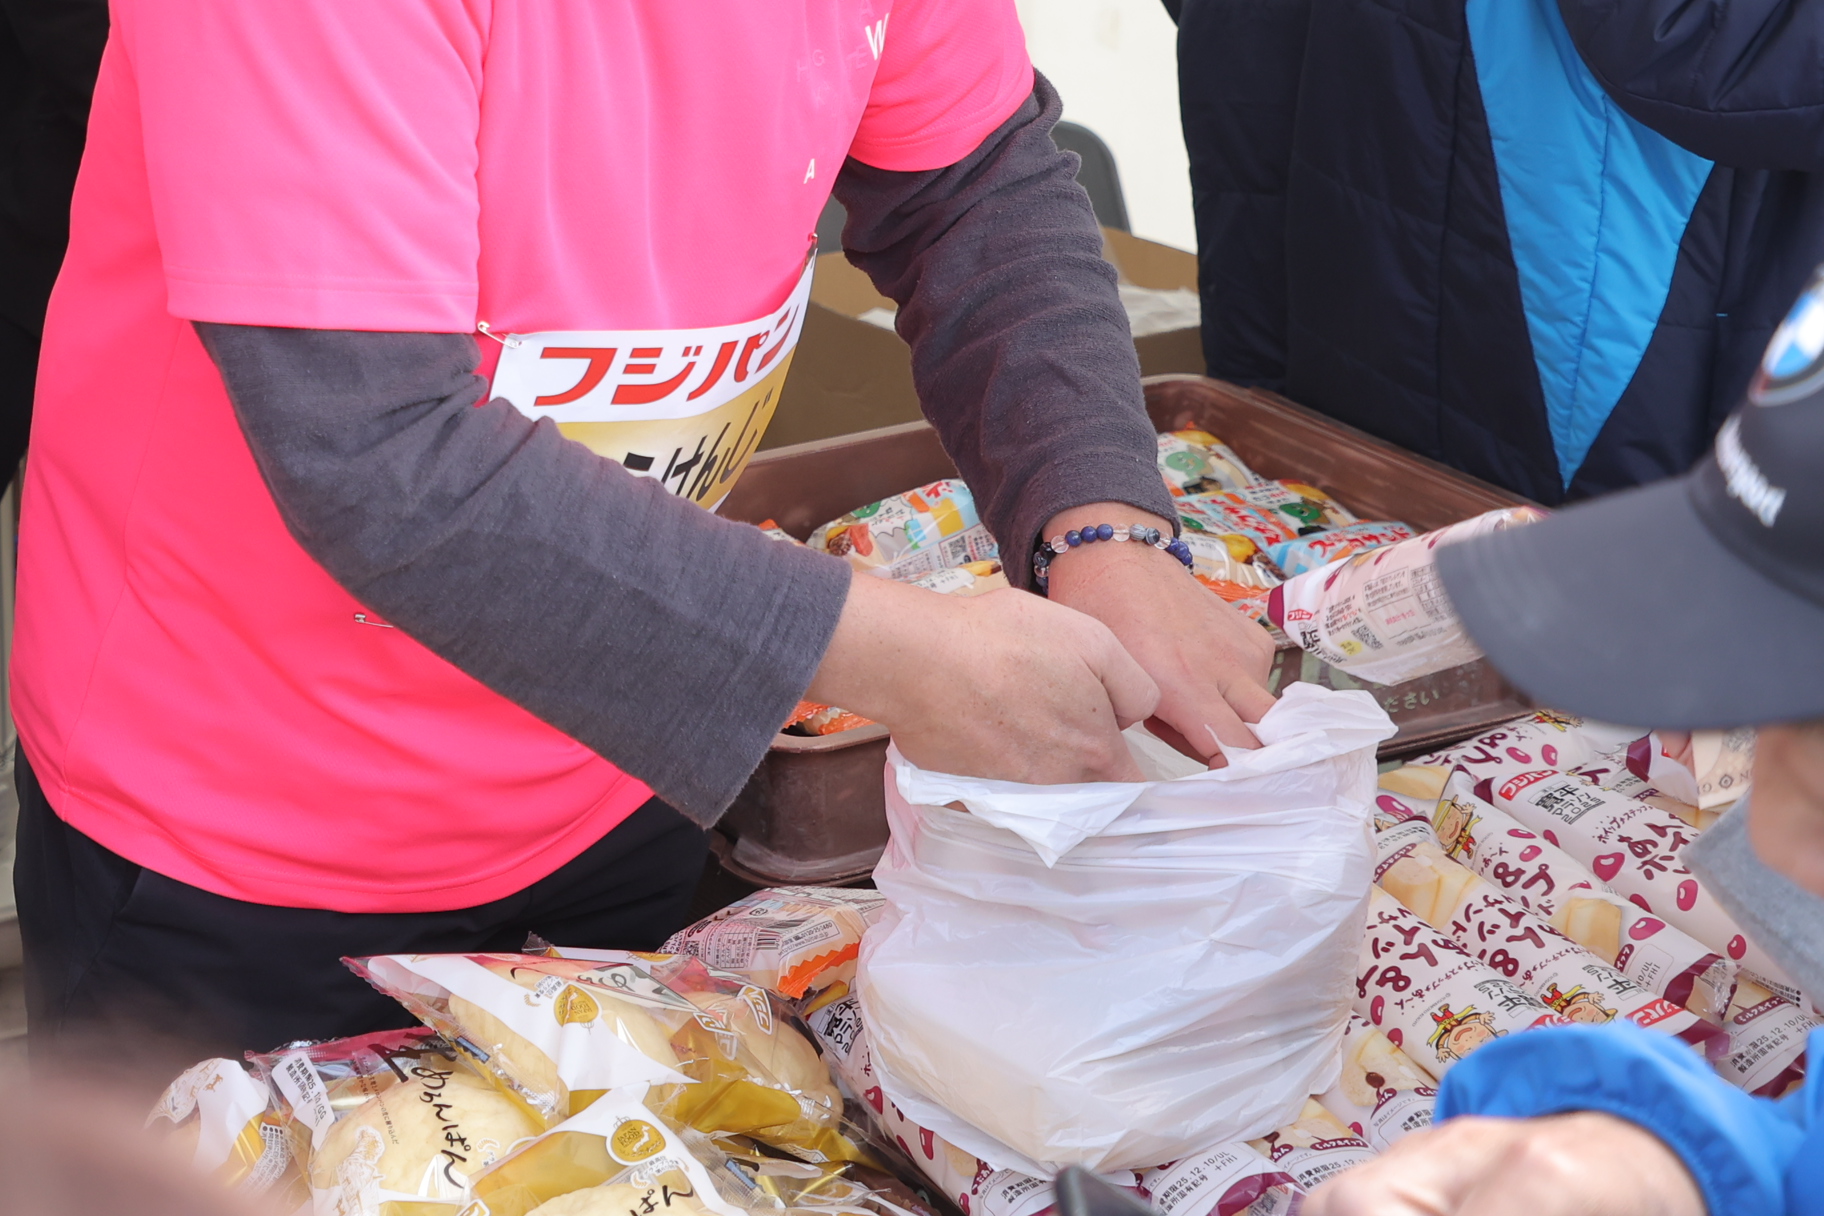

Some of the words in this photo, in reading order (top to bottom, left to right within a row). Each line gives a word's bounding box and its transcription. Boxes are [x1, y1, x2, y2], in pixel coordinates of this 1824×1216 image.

[533, 304, 800, 407] フジパン
[623, 386, 775, 502] けんじ
[1632, 1000, 1679, 1025] ジパン
[410, 1065, 472, 1190] めろんぱん
